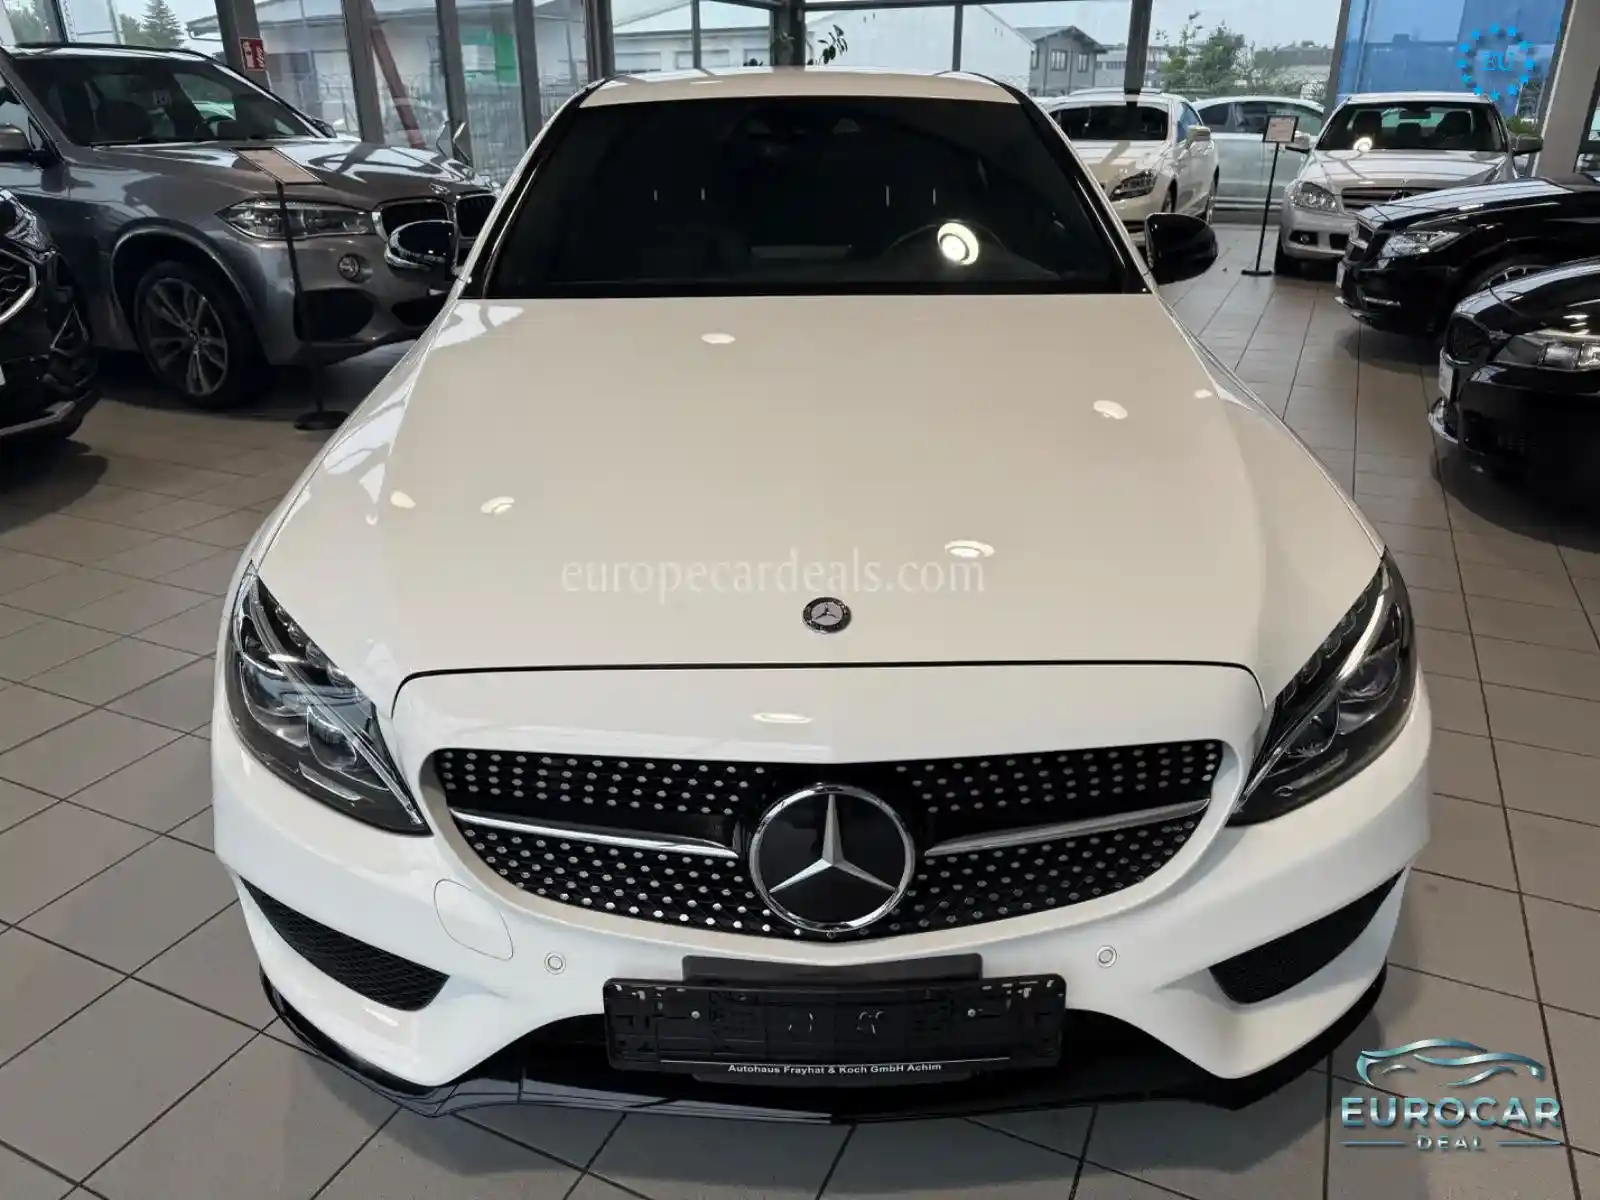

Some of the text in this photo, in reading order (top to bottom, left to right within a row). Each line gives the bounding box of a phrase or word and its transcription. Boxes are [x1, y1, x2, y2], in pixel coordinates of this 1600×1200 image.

[727, 1062, 942, 1075] Autohaus Frayhat & Koch GmbH Achim
